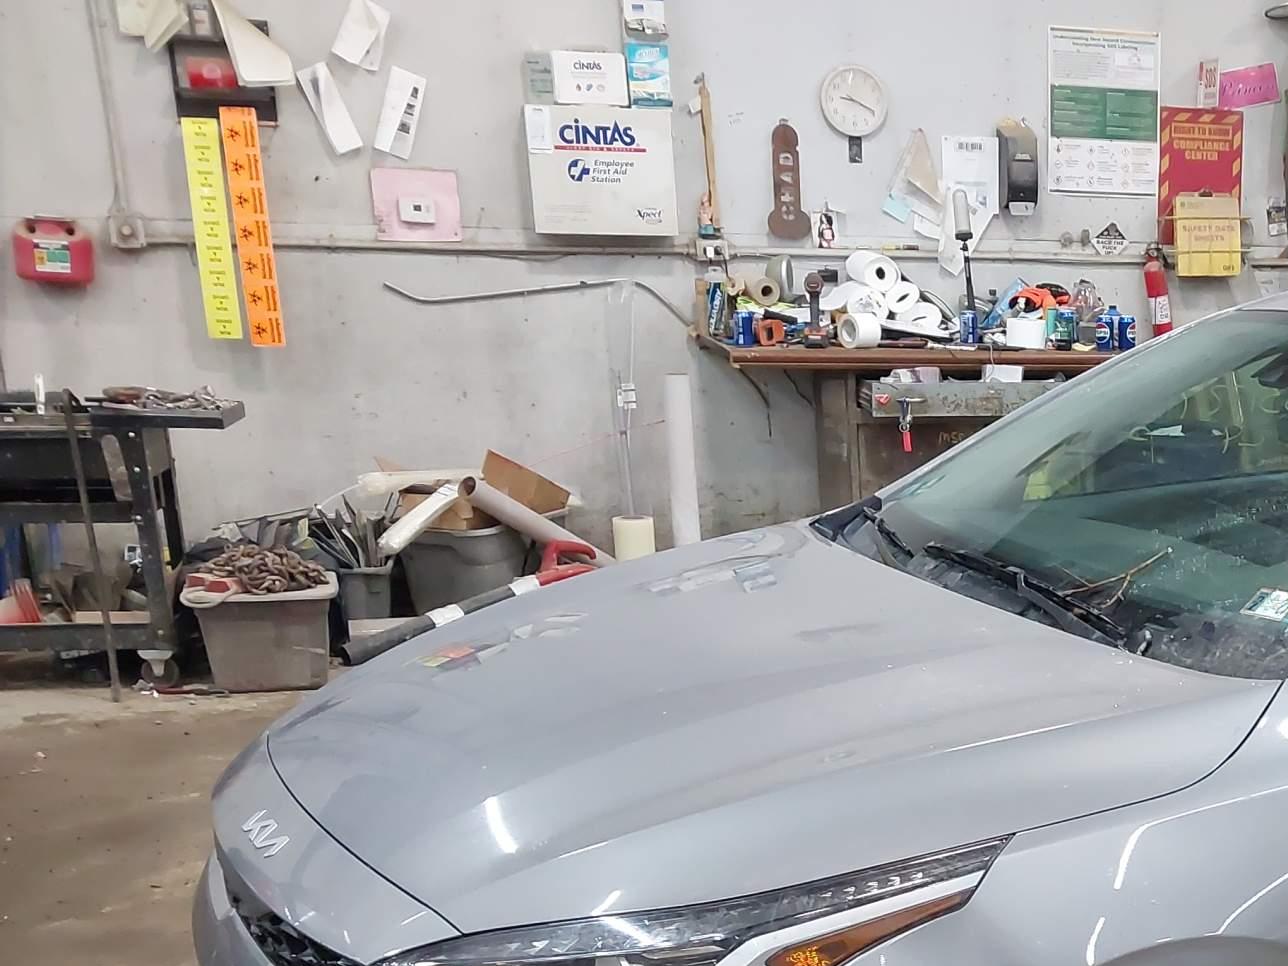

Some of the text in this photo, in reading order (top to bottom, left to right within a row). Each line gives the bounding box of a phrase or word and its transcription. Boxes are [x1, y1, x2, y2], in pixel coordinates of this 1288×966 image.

[573, 60, 602, 71] CINTAS
[559, 117, 636, 147] CINTAS
[1173, 139, 1230, 152] COMPLIANCE
[1185, 150, 1219, 161] CENTER
[594, 159, 635, 168] Employee
[612, 168, 628, 176] Aid
[591, 176, 622, 184] Station
